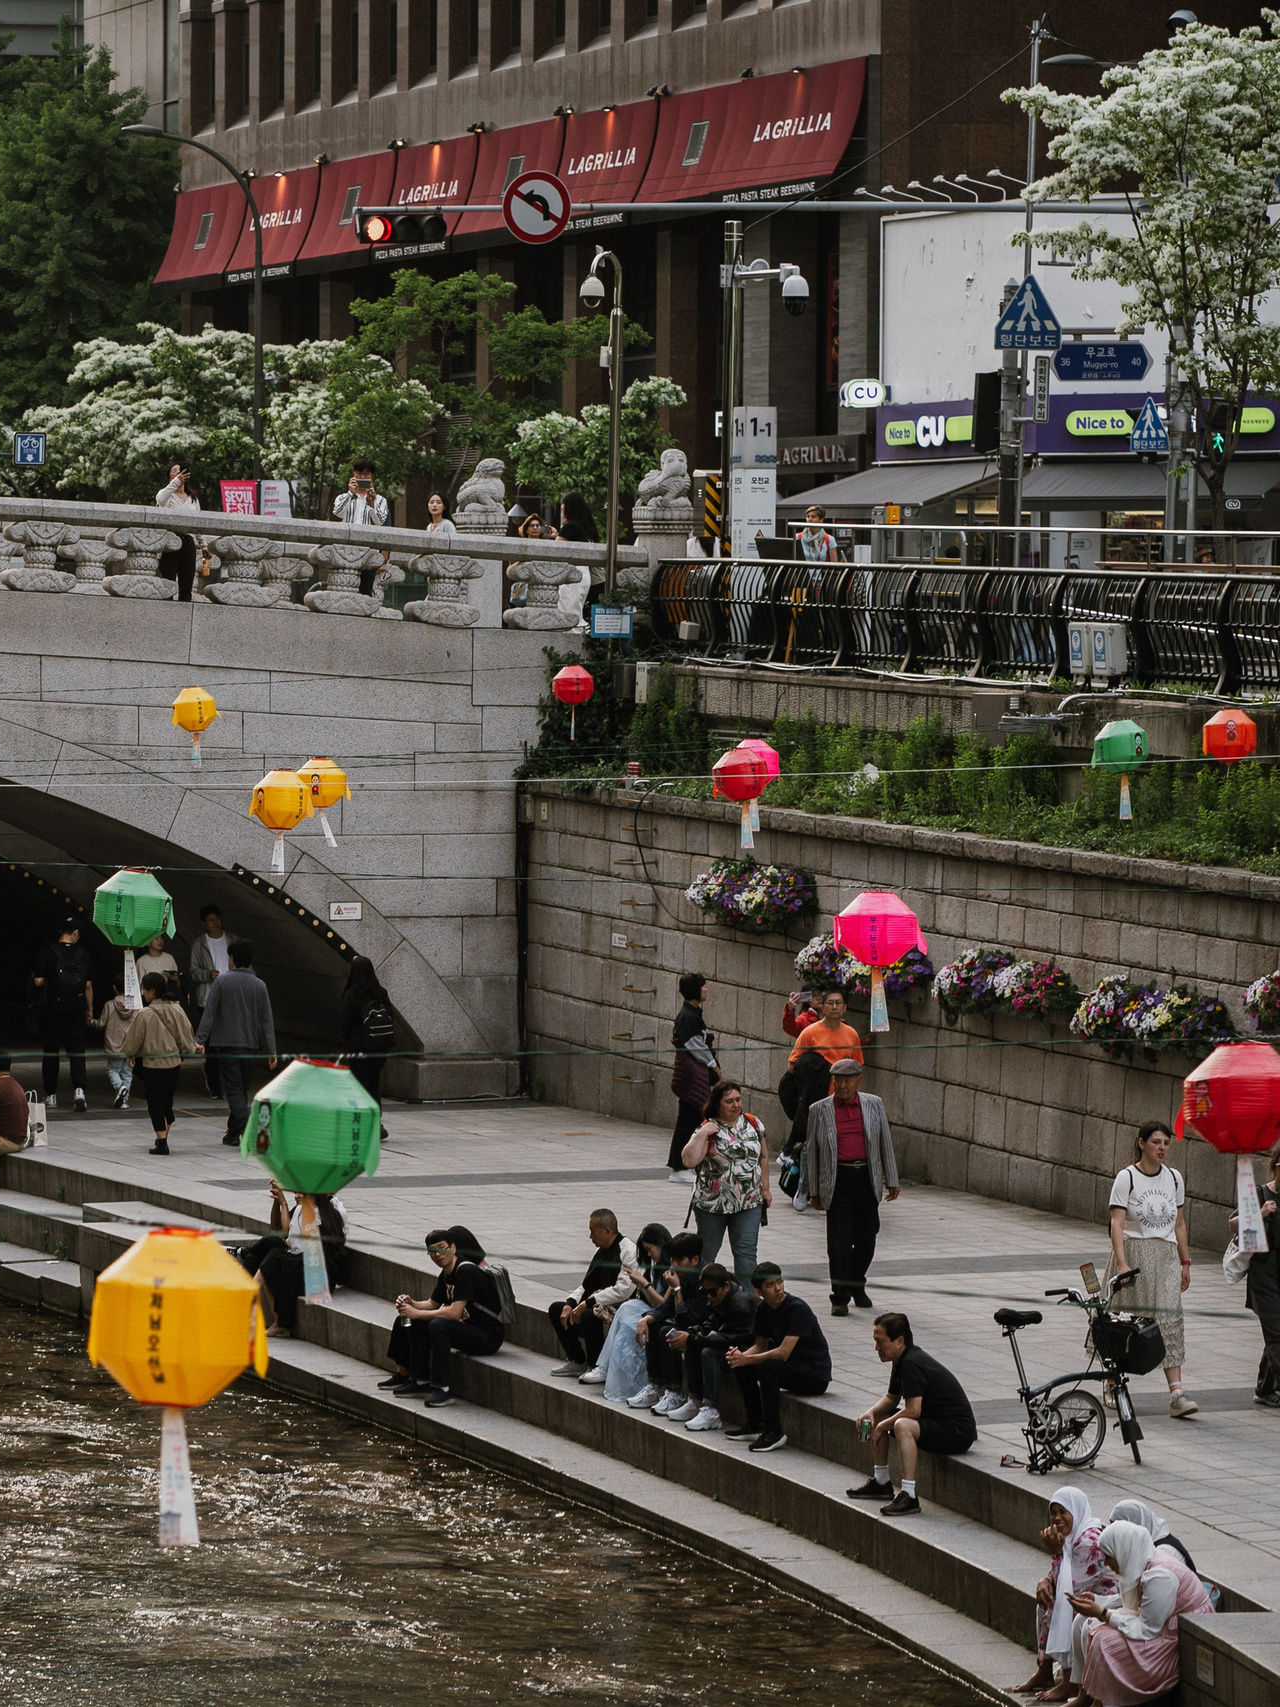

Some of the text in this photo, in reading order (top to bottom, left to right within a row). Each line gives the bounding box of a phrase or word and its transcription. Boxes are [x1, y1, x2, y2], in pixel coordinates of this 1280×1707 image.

[753, 112, 832, 142] LAGRILLIA
[567, 147, 636, 175] LAGRILLIA
[398, 180, 459, 205] LAGRILLIA
[740, 190, 758, 202] PASTA
[760, 188, 779, 200] STEAK
[249, 208, 303, 231] LGRILLIA
[575, 217, 592, 229] STEAK
[375, 250, 389, 260] PIZZA
[389, 247, 403, 257] PASTA
[403, 245, 419, 255] STEAK
[1000, 334, 1057, 347] 횡단보도
[1086, 347, 1116, 358] 무교로
[1060, 357, 1071, 366] 36
[1083, 360, 1119, 370] Mugyo-ro
[1131, 357, 1142, 366] 40
[854, 387, 878, 399] CU
[1037, 359, 1047, 419] 좌회전 차량 주의
[750, 417, 772, 437] 1-1
[1076, 416, 1125, 429] Nice to
[889, 415, 945, 448] Nice to CU
[1133, 440, 1167, 449] 횡단보도
[224, 490, 254, 503] SEOUL
[1136, 1189, 1168, 1208] NOTHING
[1136, 1210, 1177, 1229] IMPOSSIBLE
